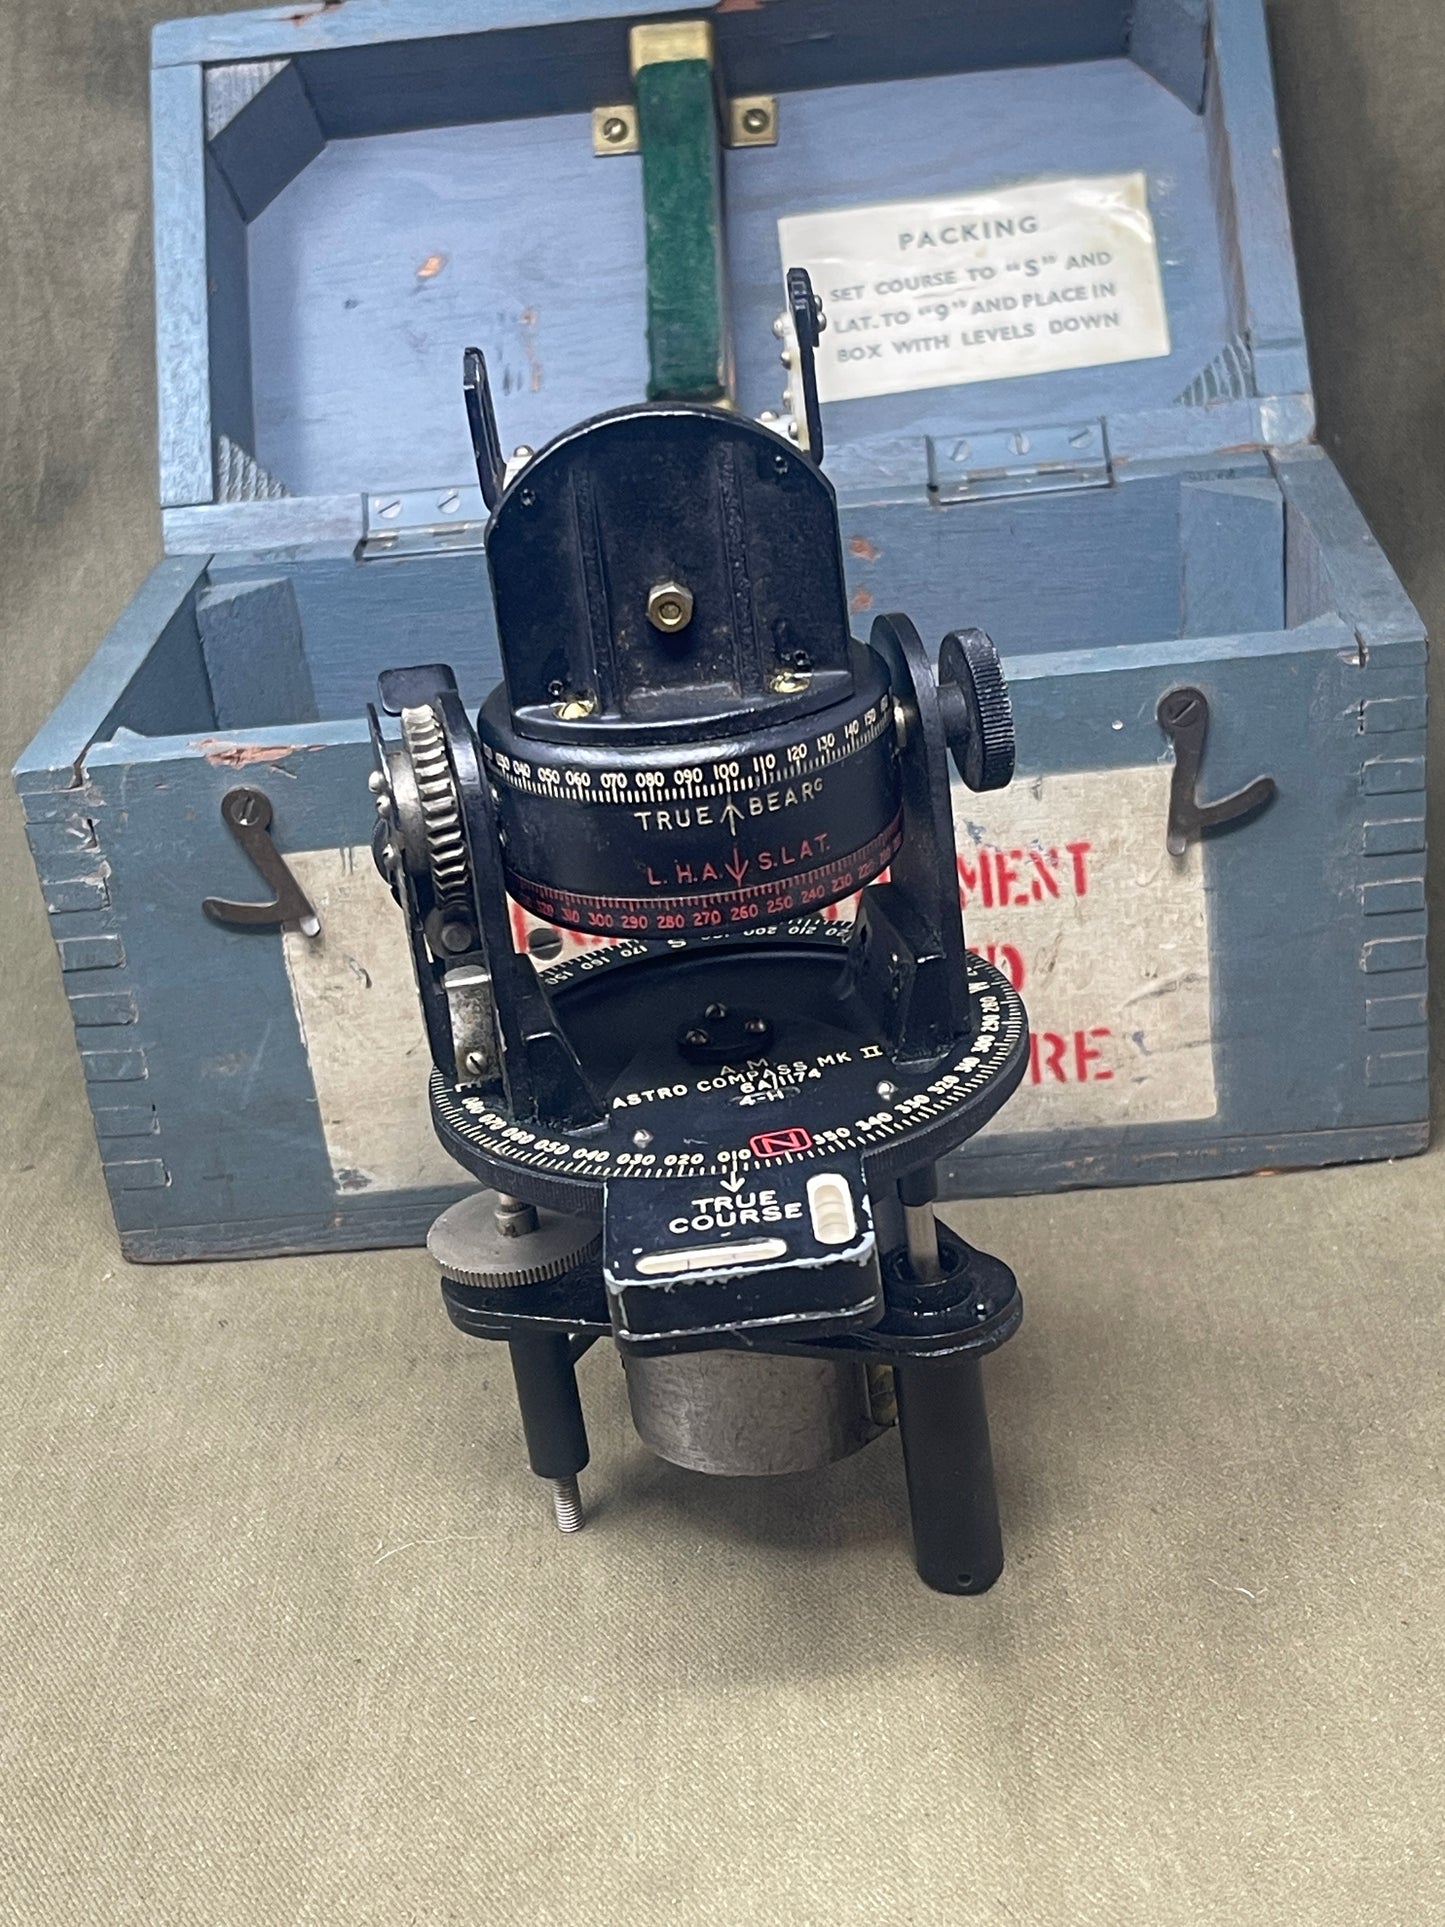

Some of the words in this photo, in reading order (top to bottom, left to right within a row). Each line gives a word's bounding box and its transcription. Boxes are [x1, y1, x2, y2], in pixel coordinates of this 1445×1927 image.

[898, 215, 1039, 251] PACKING
[829, 285, 865, 302] SET
[875, 271, 957, 295] COURSE
[966, 266, 997, 282] TO
[1065, 251, 1113, 271] AND
[880, 311, 911, 327] TO
[970, 296, 1019, 315] AND
[1021, 286, 1089, 308] PLACE
[1091, 281, 1117, 299] IN
[836, 344, 882, 362] BOX
[890, 334, 950, 354] WITH
[961, 322, 1036, 346] LEVELS
[1048, 312, 1120, 334] DOWN
[537, 767, 560, 784] 050
[565, 771, 591, 787] 060
[601, 773, 628, 789] 070
[635, 772, 665, 788] 080
[673, 769, 703, 785] 090
[713, 762, 740, 780] 100
[753, 753, 777, 773] 110
[787, 743, 808, 762] 120
[816, 733, 836, 751] 130
[633, 806, 714, 832] TRUE
[749, 777, 824, 817] BEARG
[587, 911, 614, 928] 300
[621, 915, 649, 930] 290
[656, 914, 685, 930] 280
[693, 911, 722, 927] 270
[730, 904, 759, 922] 260
[767, 896, 794, 914] 250
[801, 885, 825, 904] 240
[831, 873, 853, 891] 230
[612, 1084, 689, 1110] ASTRO
[696, 1060, 808, 1093] COMPASS
[816, 1051, 853, 1068] MK
[859, 1045, 884, 1060] II
[739, 1067, 822, 1094] 6A/1174
[501, 1127, 537, 1145] 060
[533, 1138, 571, 1156] 050
[572, 1148, 611, 1162] 040
[616, 1153, 656, 1166] 030
[664, 1152, 704, 1166] 020
[717, 1149, 752, 1163] 010
[762, 1132, 799, 1154] N
[812, 1127, 852, 1146] 350
[855, 1112, 893, 1131] 340
[894, 1094, 931, 1114] 330
[926, 1074, 960, 1095] 320
[668, 1202, 804, 1235] COURSE
[691, 1189, 779, 1215] TRUE
